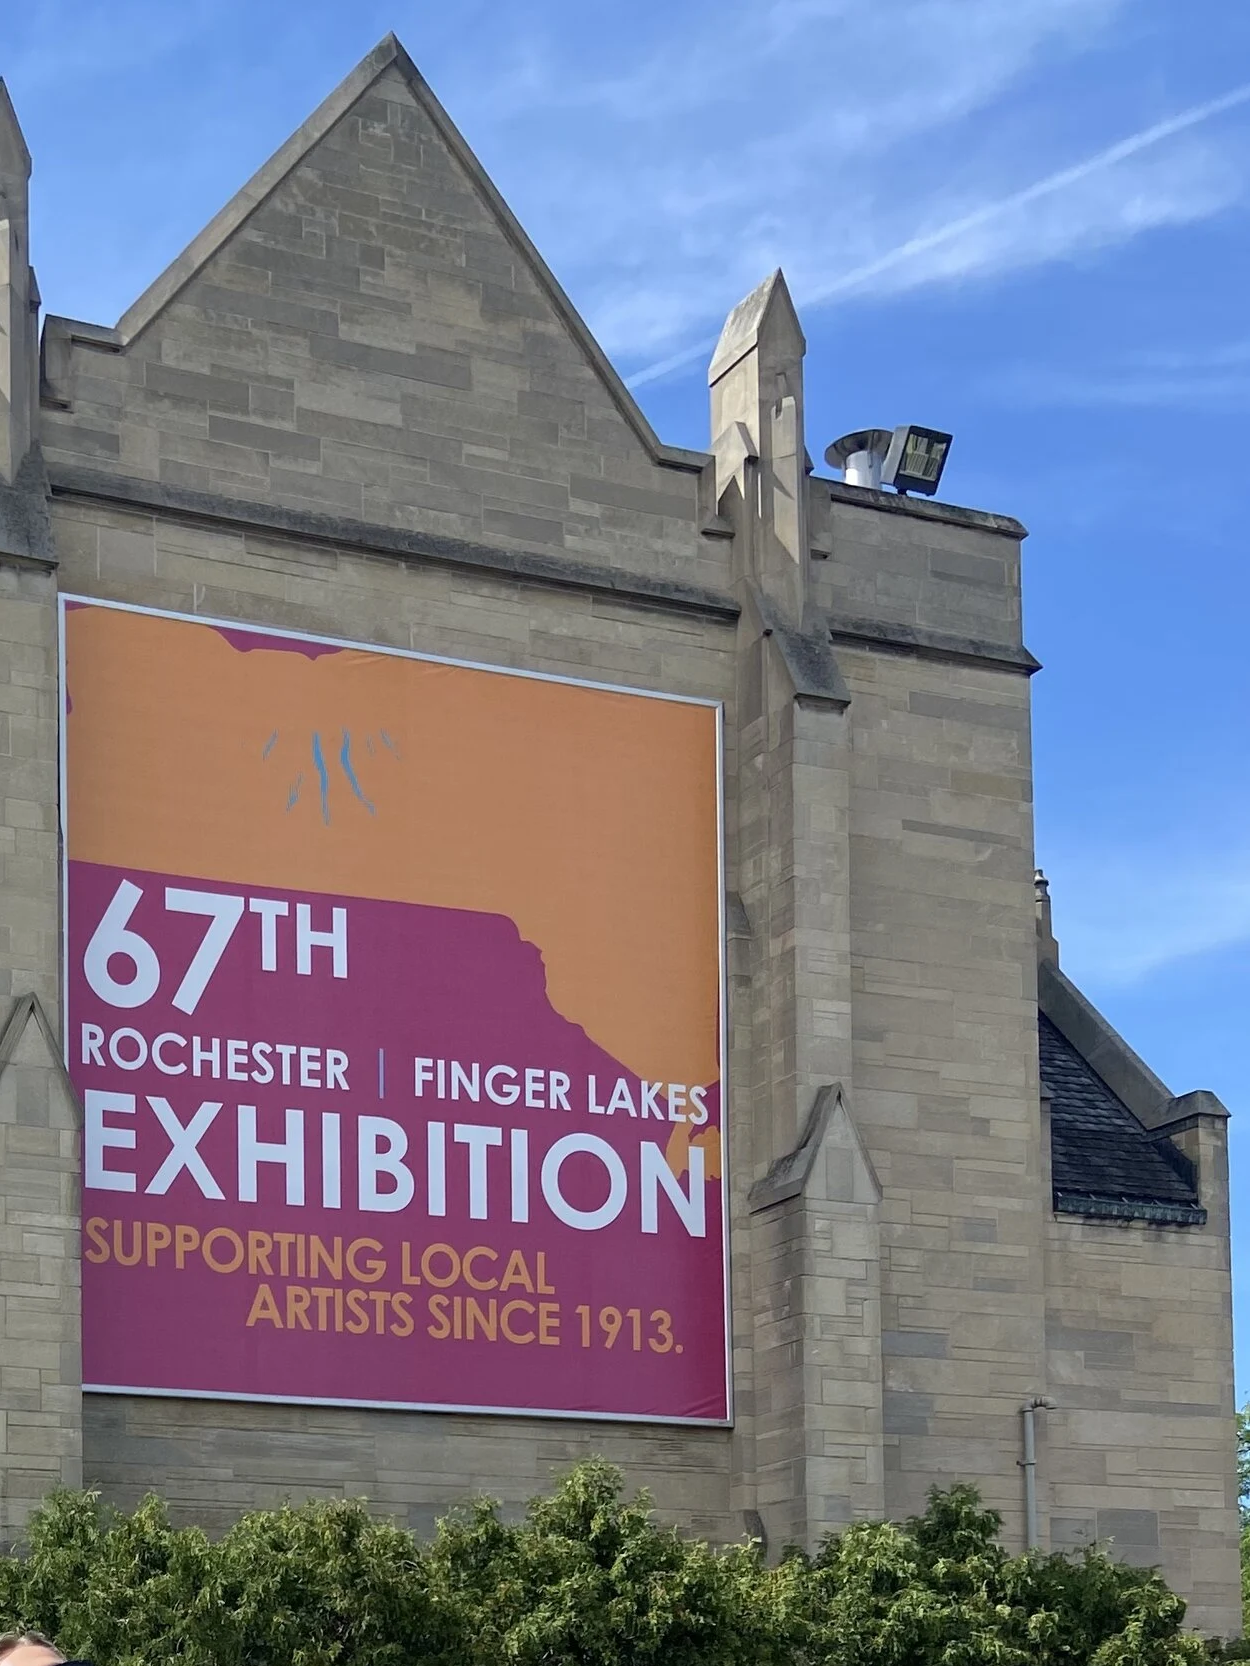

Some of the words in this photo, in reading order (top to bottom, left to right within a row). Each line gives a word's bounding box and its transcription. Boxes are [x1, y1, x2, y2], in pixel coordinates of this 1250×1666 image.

[83, 878, 349, 1016] 67TH
[81, 1022, 350, 1091] ROCHESTER
[414, 1056, 571, 1112] FINGER
[587, 1073, 709, 1126] LAKES
[83, 1088, 707, 1238] EXHIBITION
[84, 1215, 387, 1284] SUPPORTING
[401, 1241, 555, 1295] LOCAL
[245, 1283, 415, 1338] ARTISTS
[427, 1294, 561, 1347] SINCE
[574, 1304, 685, 1354] 1913.
